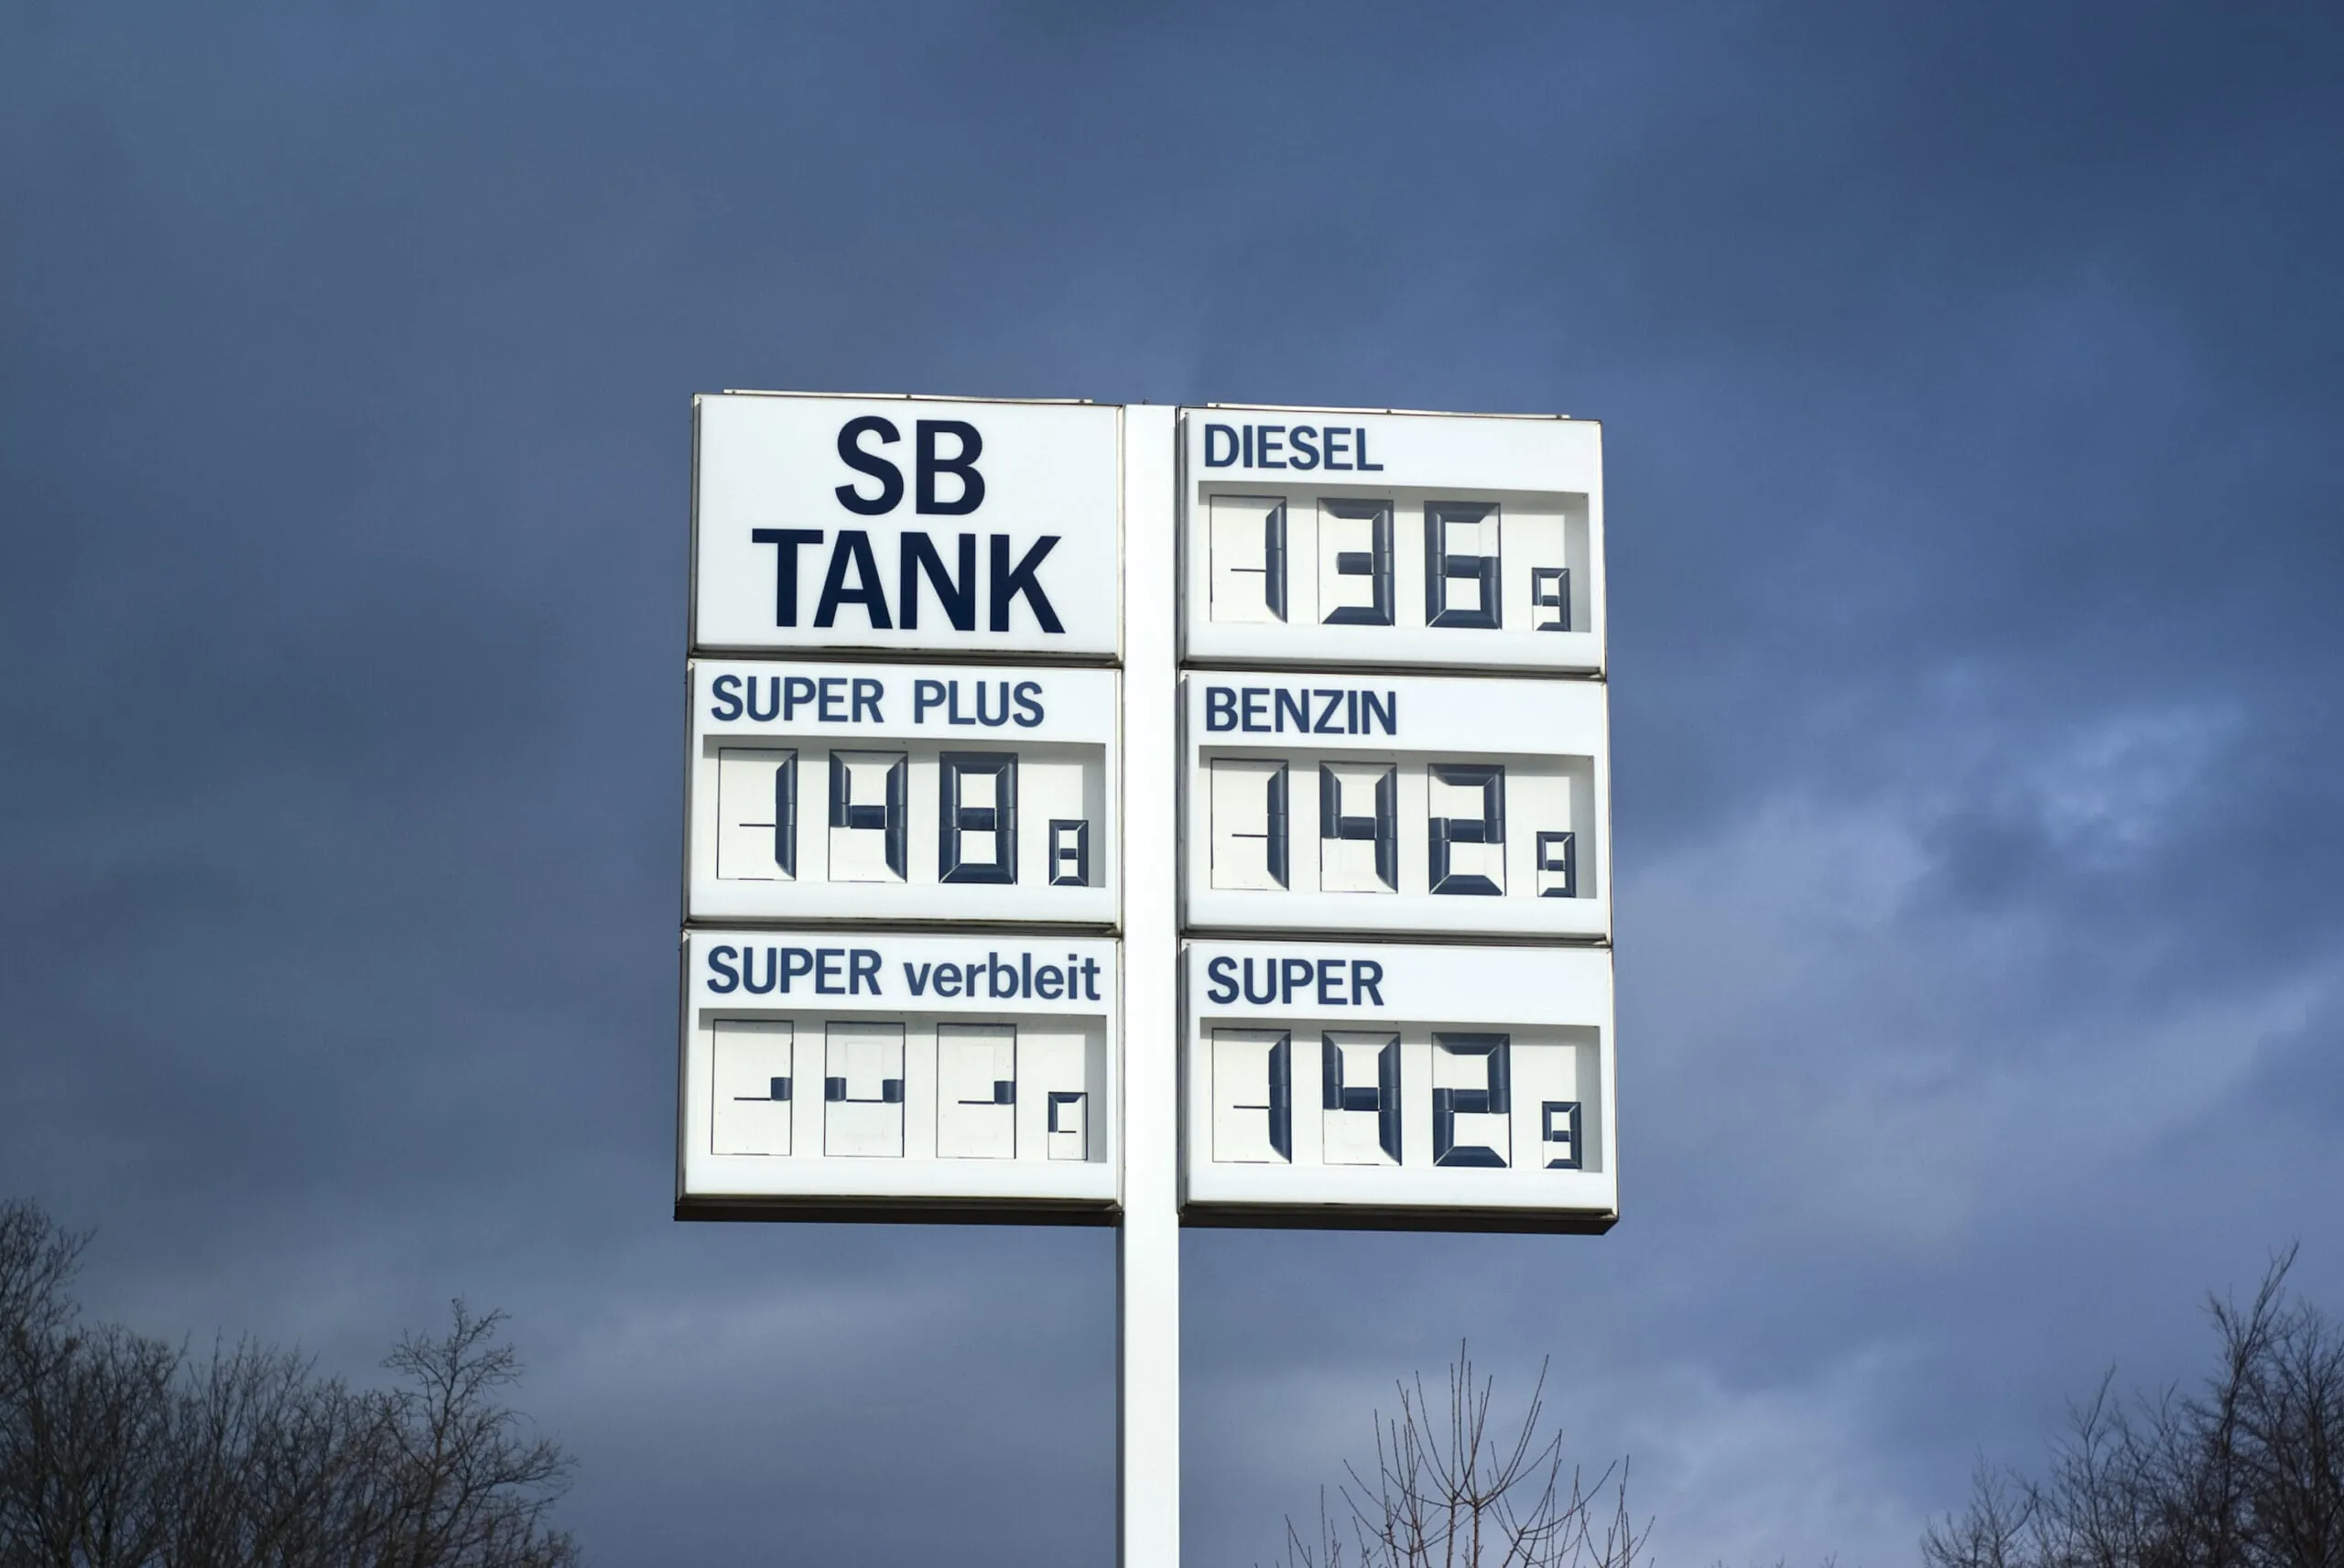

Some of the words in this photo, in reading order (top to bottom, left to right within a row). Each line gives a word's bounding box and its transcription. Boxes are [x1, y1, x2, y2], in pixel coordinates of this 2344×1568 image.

[834, 416, 986, 515] SB
[1204, 424, 1384, 471] DIESEL
[752, 528, 1066, 633] TANK
[711, 675, 884, 723] SUPER
[914, 680, 1045, 728] PLUS
[1205, 687, 1397, 735] BENZIN
[706, 945, 883, 996] SUPER
[904, 952, 1101, 1001] verbleit
[1207, 956, 1384, 1006] SUPER
